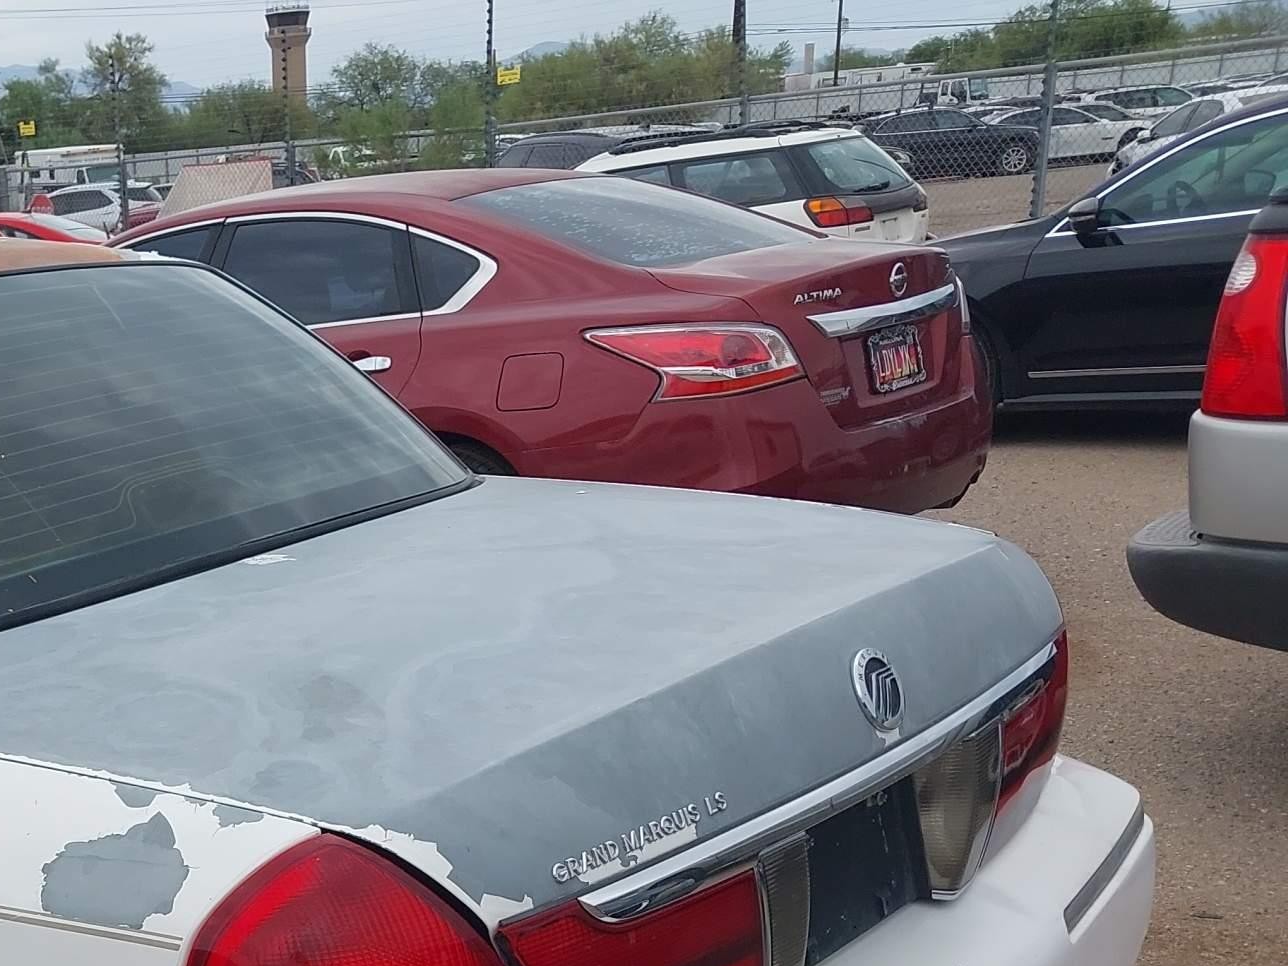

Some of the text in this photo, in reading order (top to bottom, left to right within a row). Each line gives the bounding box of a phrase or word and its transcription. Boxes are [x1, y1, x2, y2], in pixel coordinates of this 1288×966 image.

[793, 287, 842, 305] ALTIMA
[552, 791, 728, 883] GRAND MARQUIS LS
